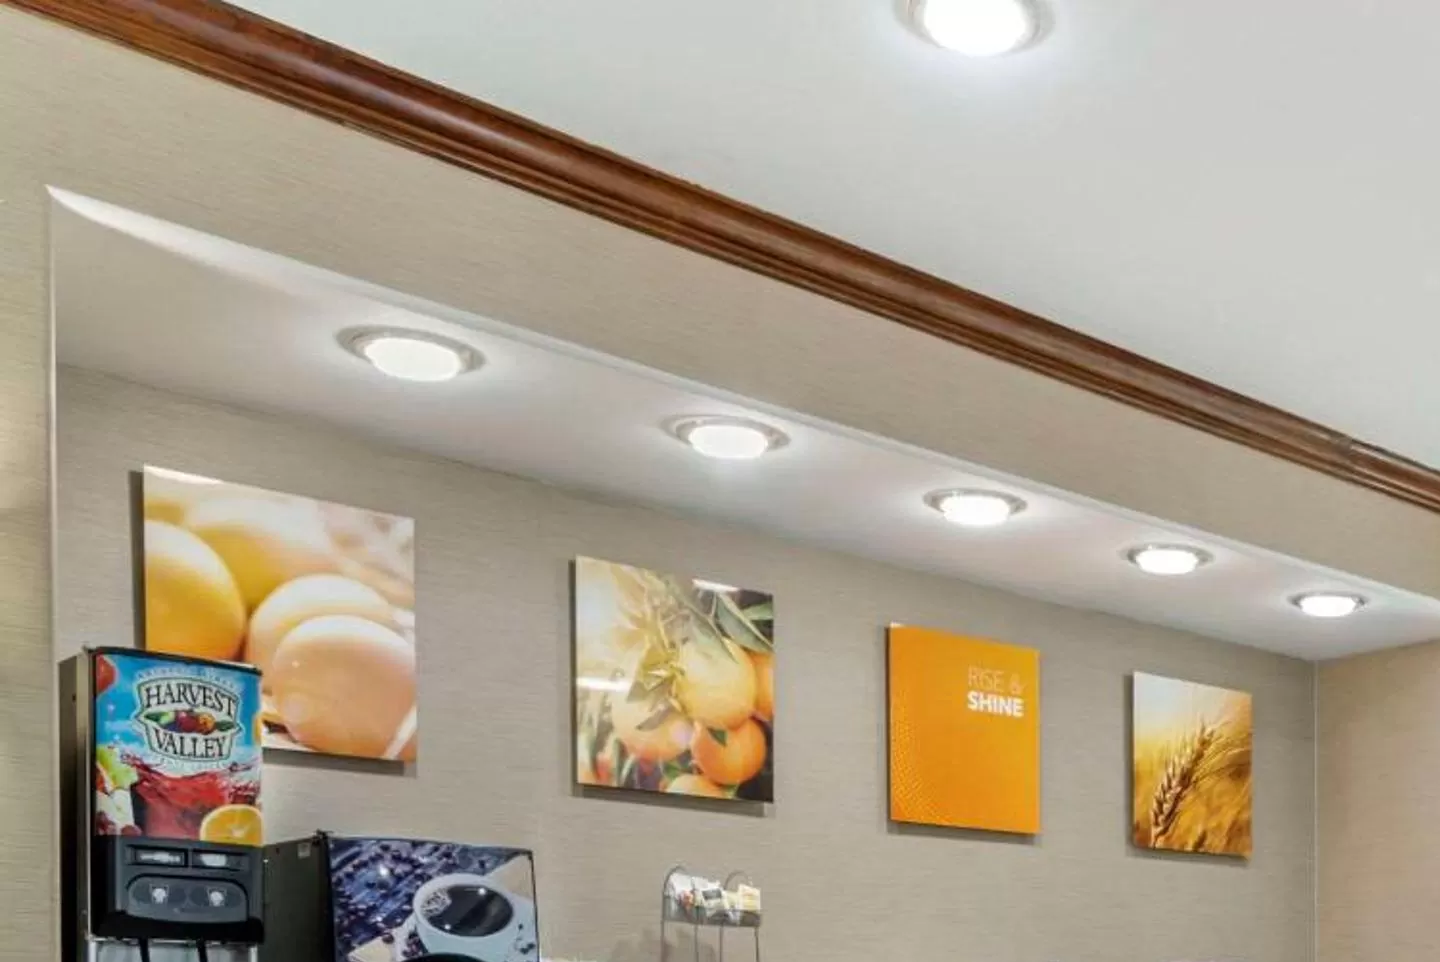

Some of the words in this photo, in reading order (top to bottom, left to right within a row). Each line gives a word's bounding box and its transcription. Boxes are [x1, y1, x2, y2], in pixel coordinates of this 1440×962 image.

[967, 665, 1005, 692] RISE
[1009, 673, 1028, 696] &
[144, 681, 237, 717] HARVEST
[967, 690, 1025, 718] SHINE
[154, 726, 227, 759] VALLEY
